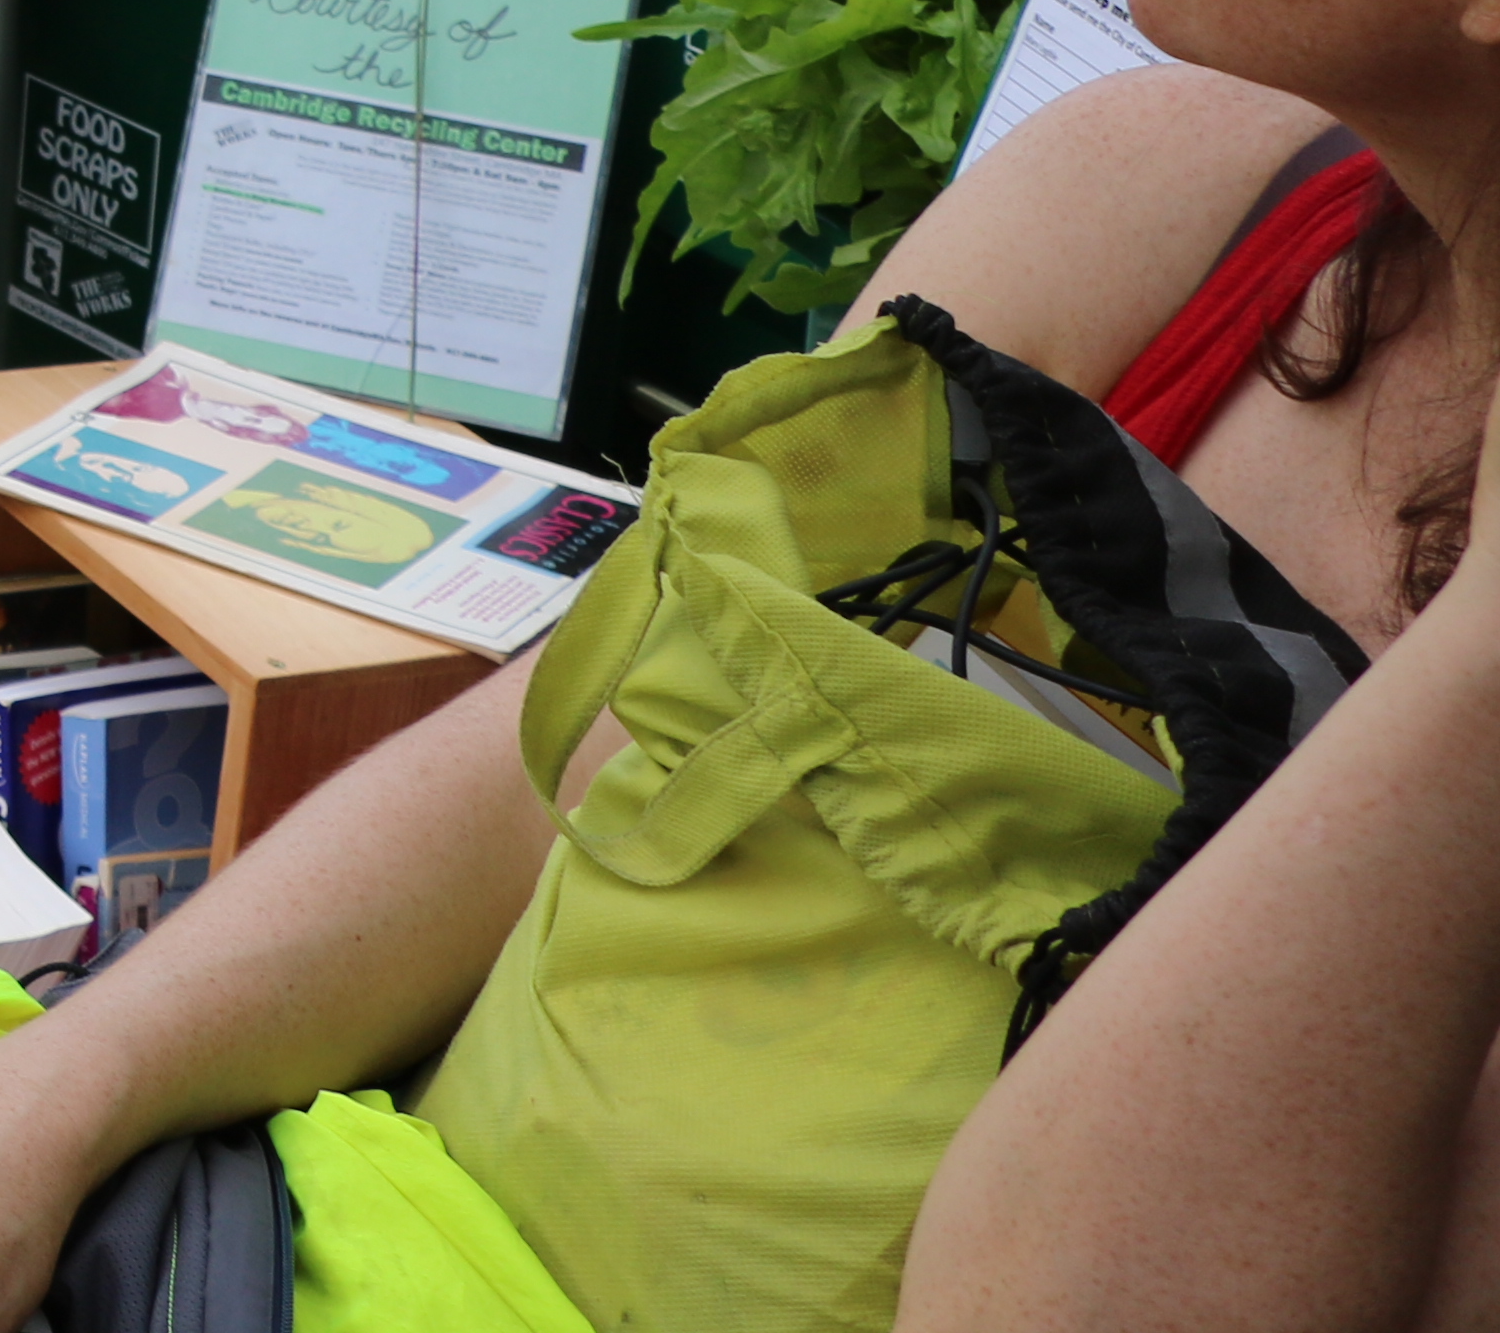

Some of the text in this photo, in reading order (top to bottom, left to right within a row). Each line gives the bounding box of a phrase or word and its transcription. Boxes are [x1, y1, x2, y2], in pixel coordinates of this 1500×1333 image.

[447, 5, 518, 61] of
[1110, 2, 1131, 25] me
[312, 44, 415, 90] the
[56, 95, 126, 155] FOOD
[220, 80, 571, 166] Cambridge Recycling Center
[37, 126, 139, 201] SCRAPS
[52, 174, 120, 228] ONLY
[499, 493, 617, 562] CLASSICS
[79, 732, 89, 785] KAPLAN
